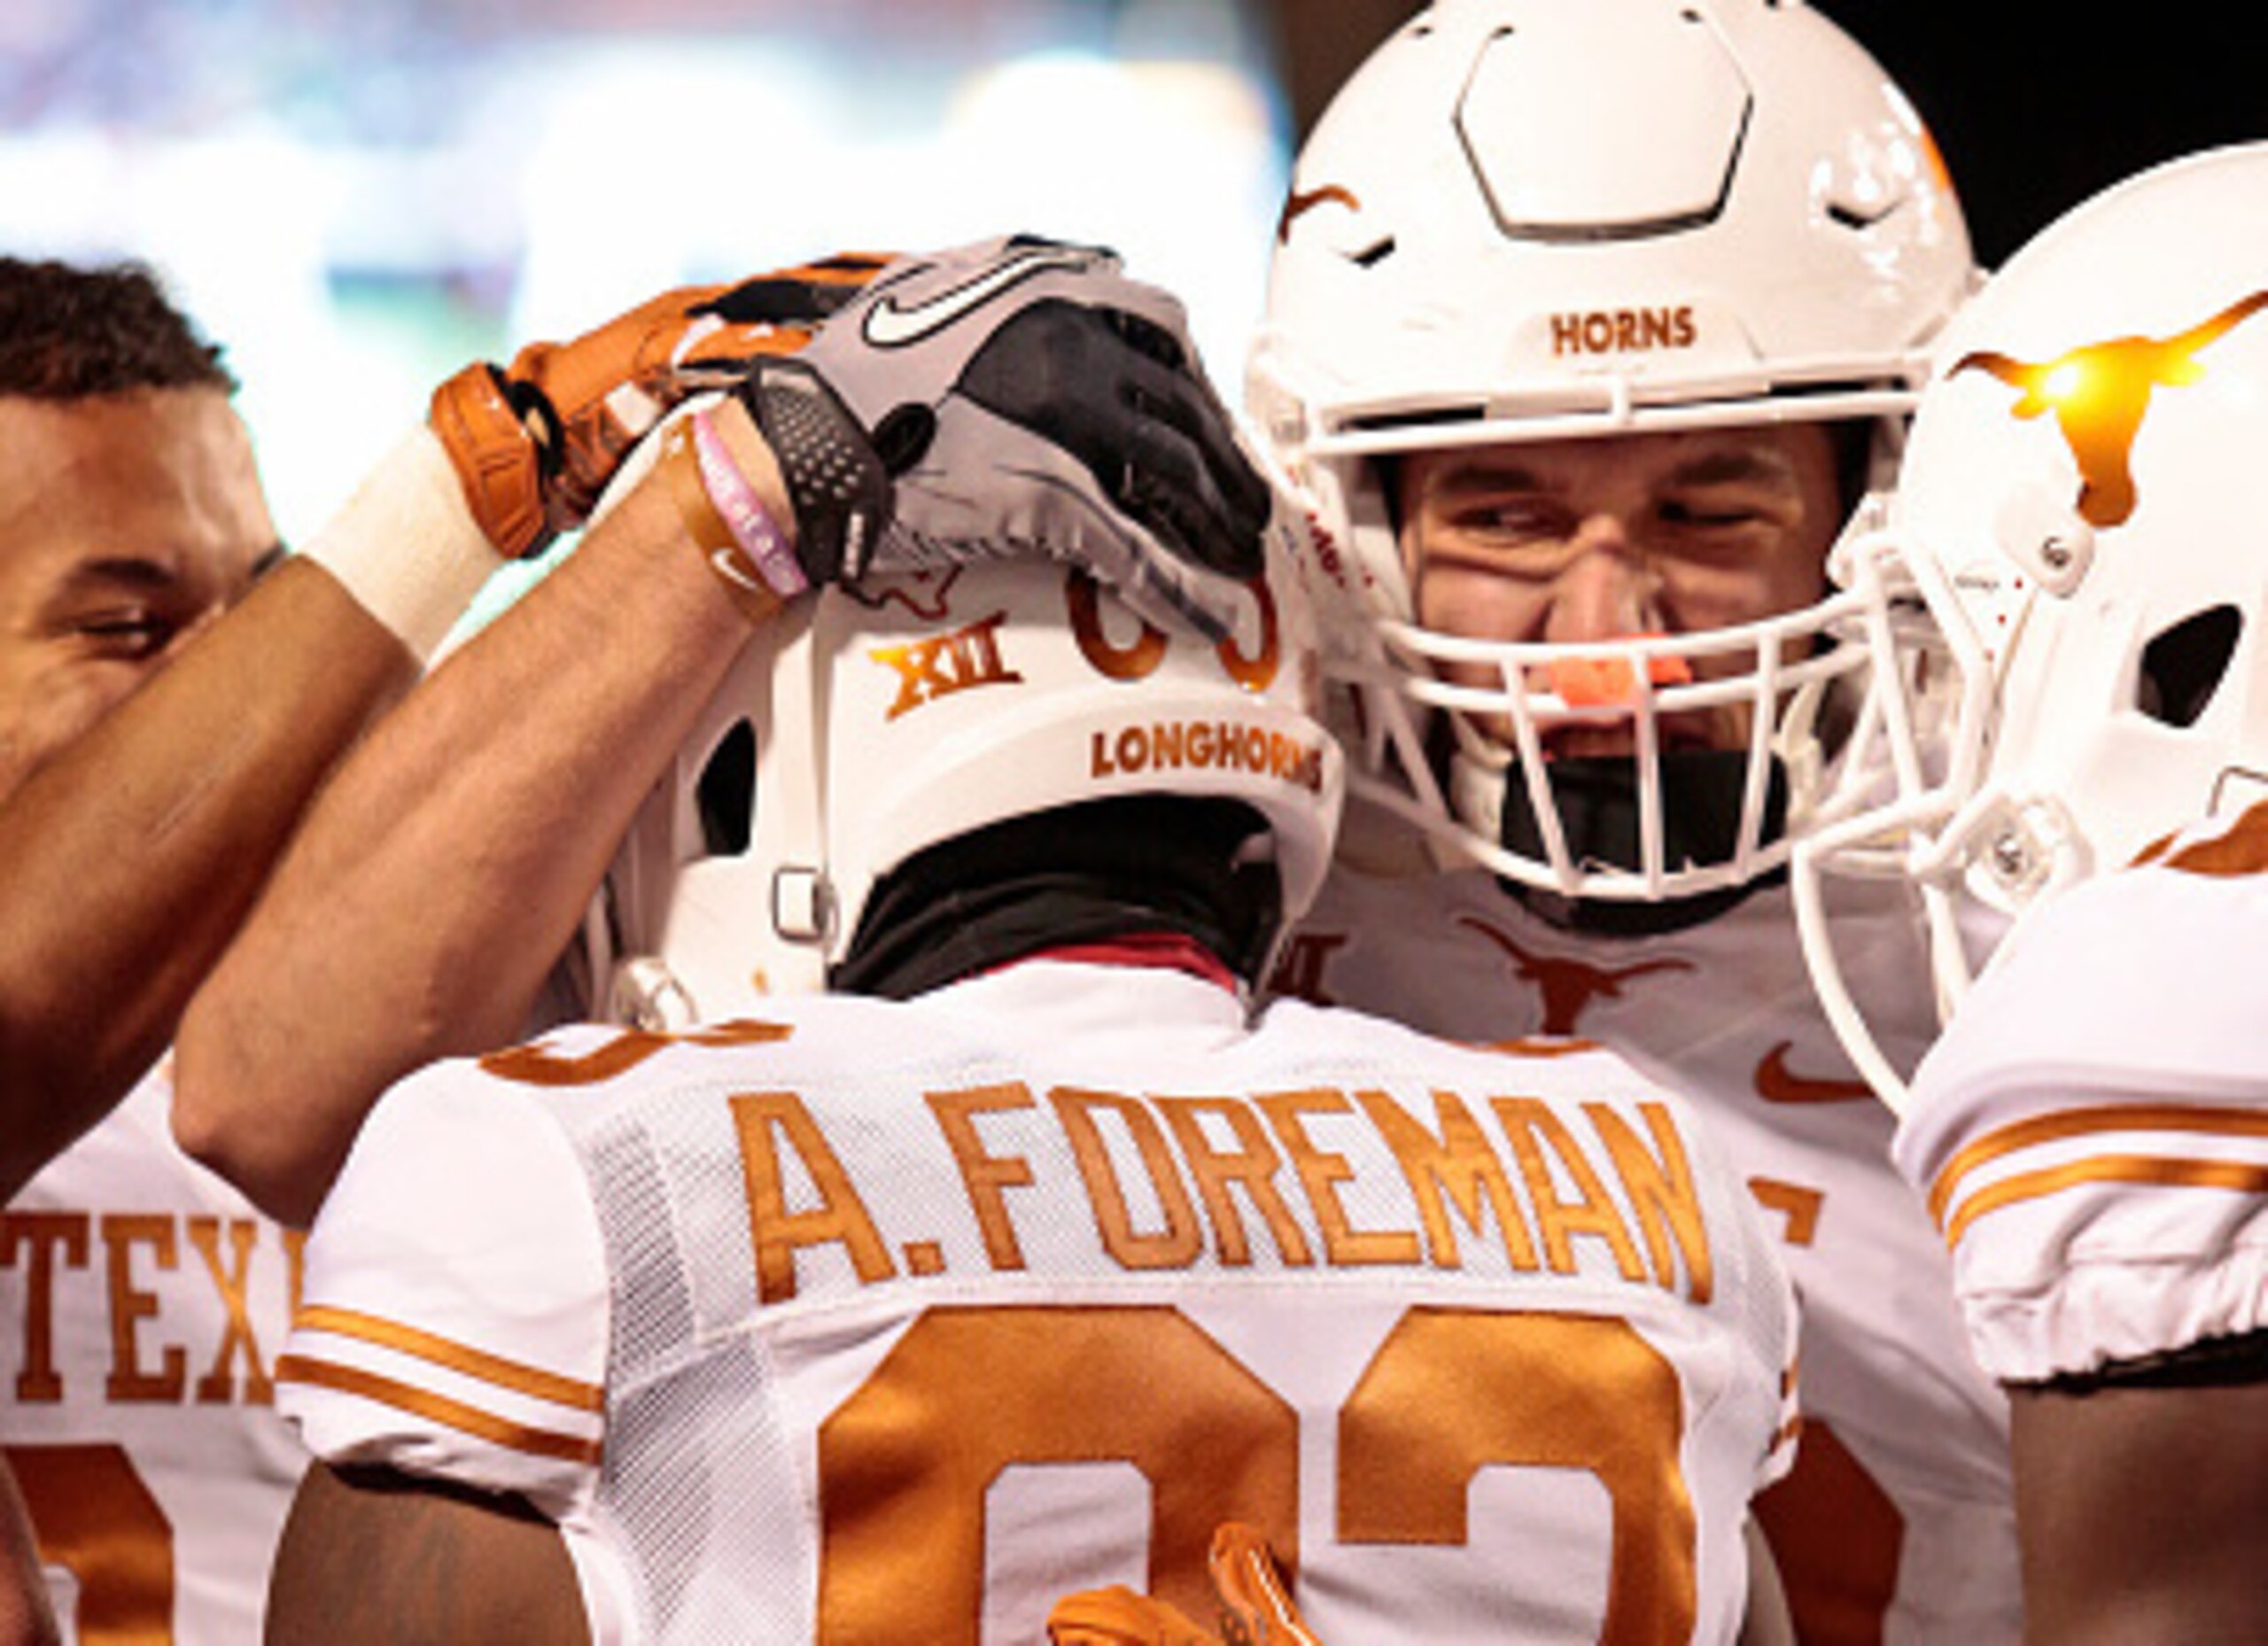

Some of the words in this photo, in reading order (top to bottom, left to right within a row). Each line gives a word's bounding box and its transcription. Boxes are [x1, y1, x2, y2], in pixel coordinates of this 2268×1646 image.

[1550, 307, 1696, 355] HORNS
[868, 610, 1025, 722] XII
[1091, 720, 1323, 795] LONGHORNS
[0, 1210, 308, 1405] TEX
